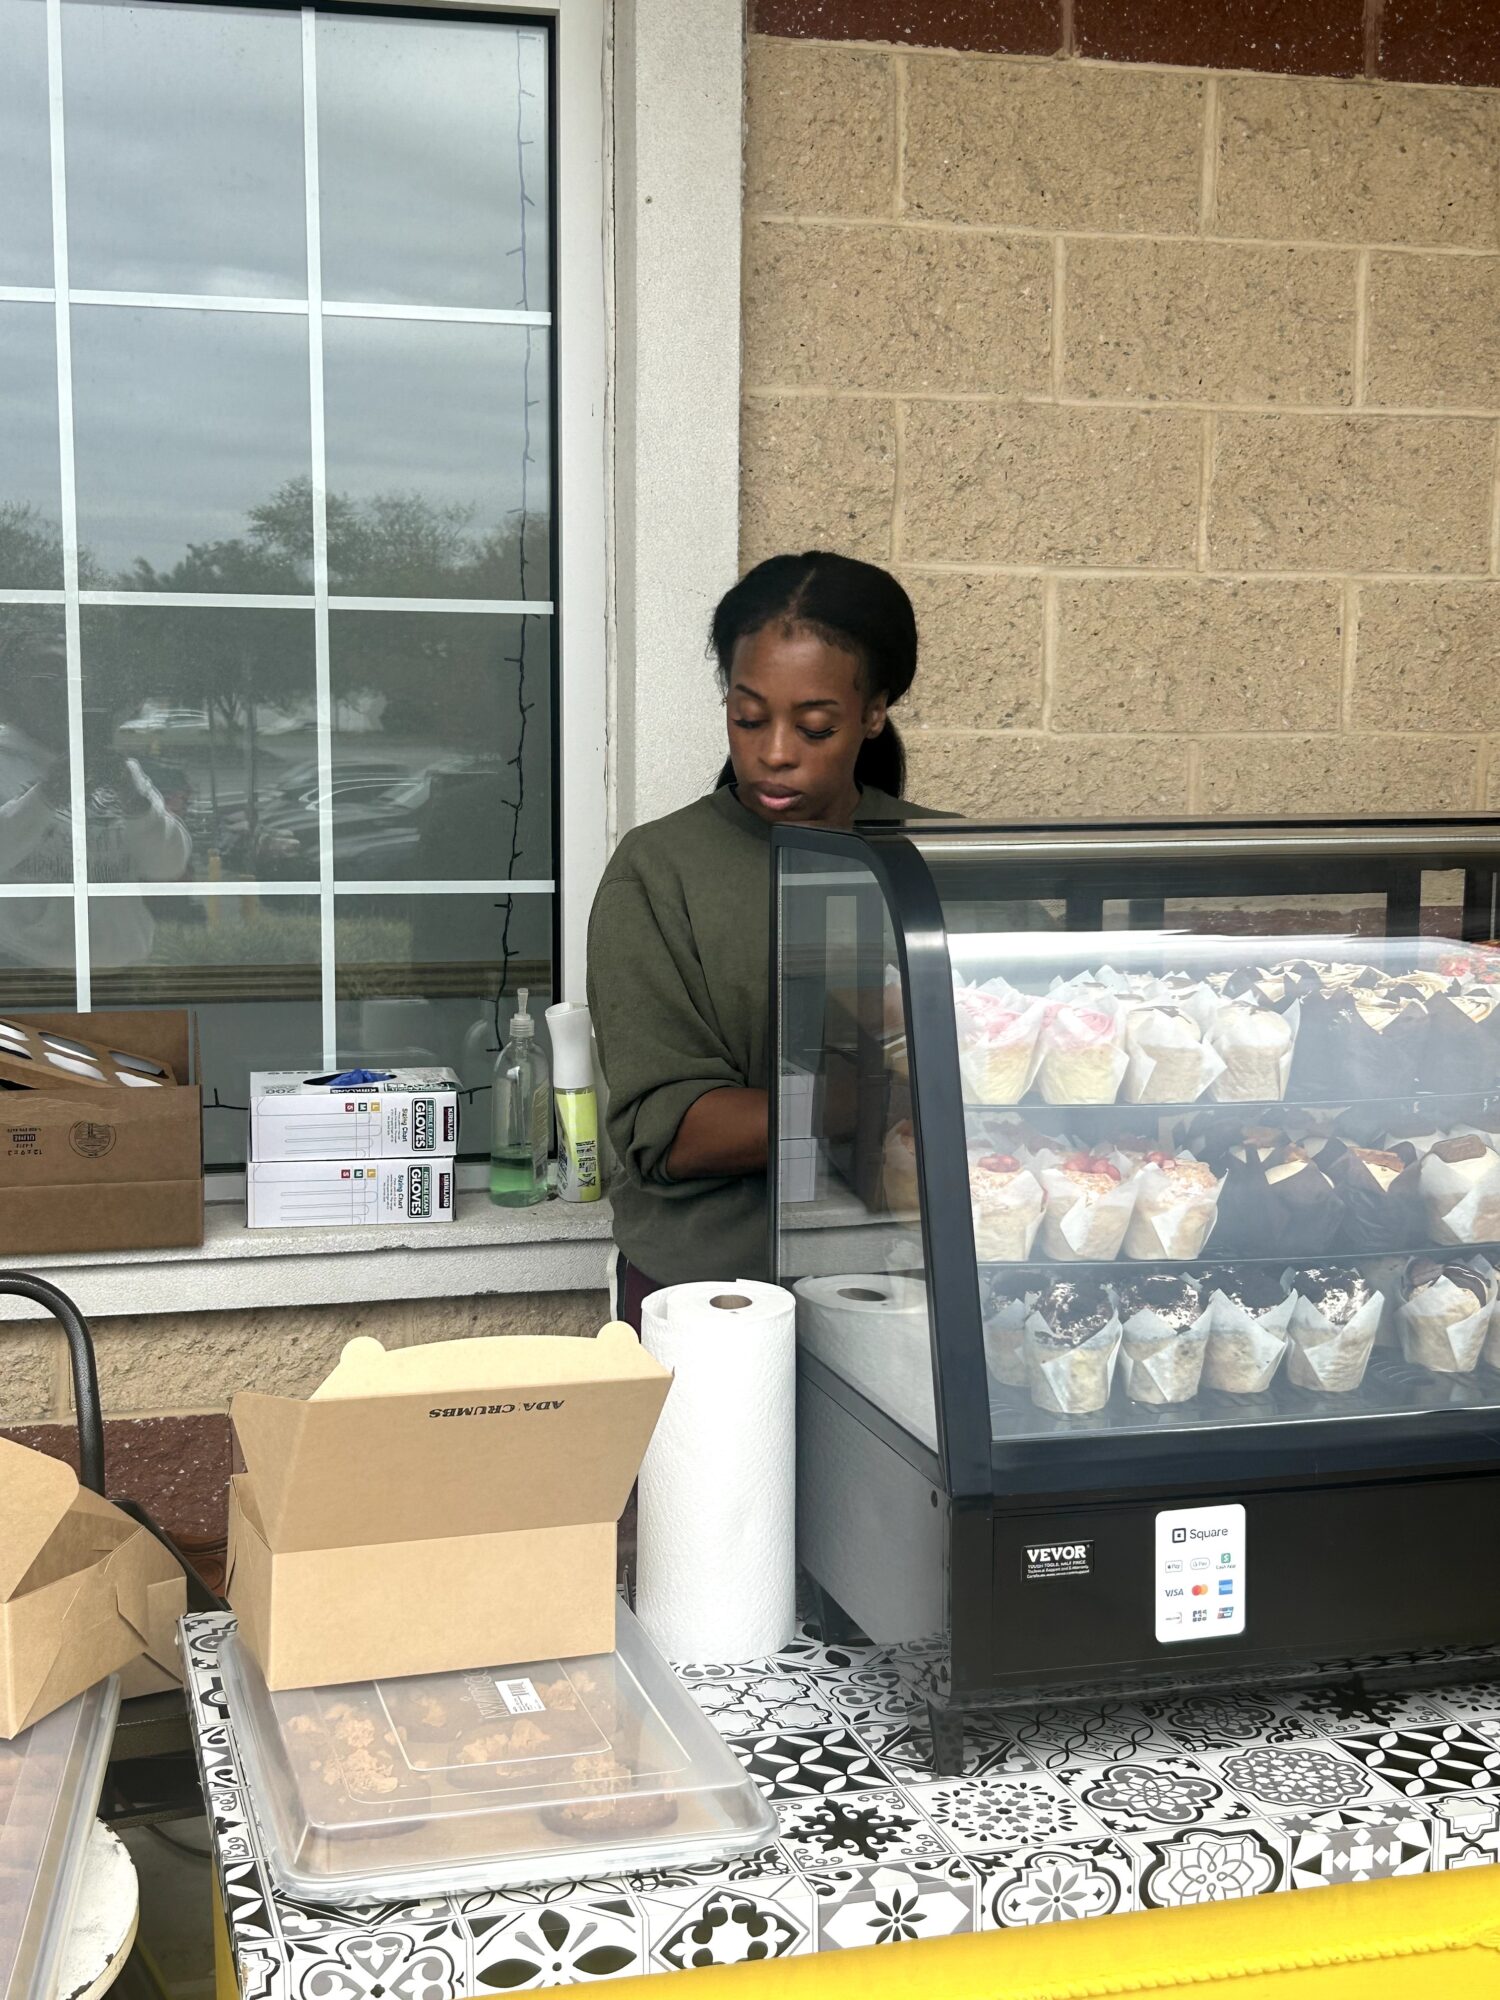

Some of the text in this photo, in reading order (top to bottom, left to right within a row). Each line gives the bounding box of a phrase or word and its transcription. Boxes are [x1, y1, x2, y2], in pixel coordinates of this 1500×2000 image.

[415, 1102, 426, 1148] GLOVES
[411, 1169, 422, 1215] GLOVES
[429, 1404, 516, 1418] CRUMBS
[1189, 1528, 1229, 1541] Square
[1027, 1545, 1087, 1563] VEVOR
[1164, 1588, 1184, 1597] VISA
